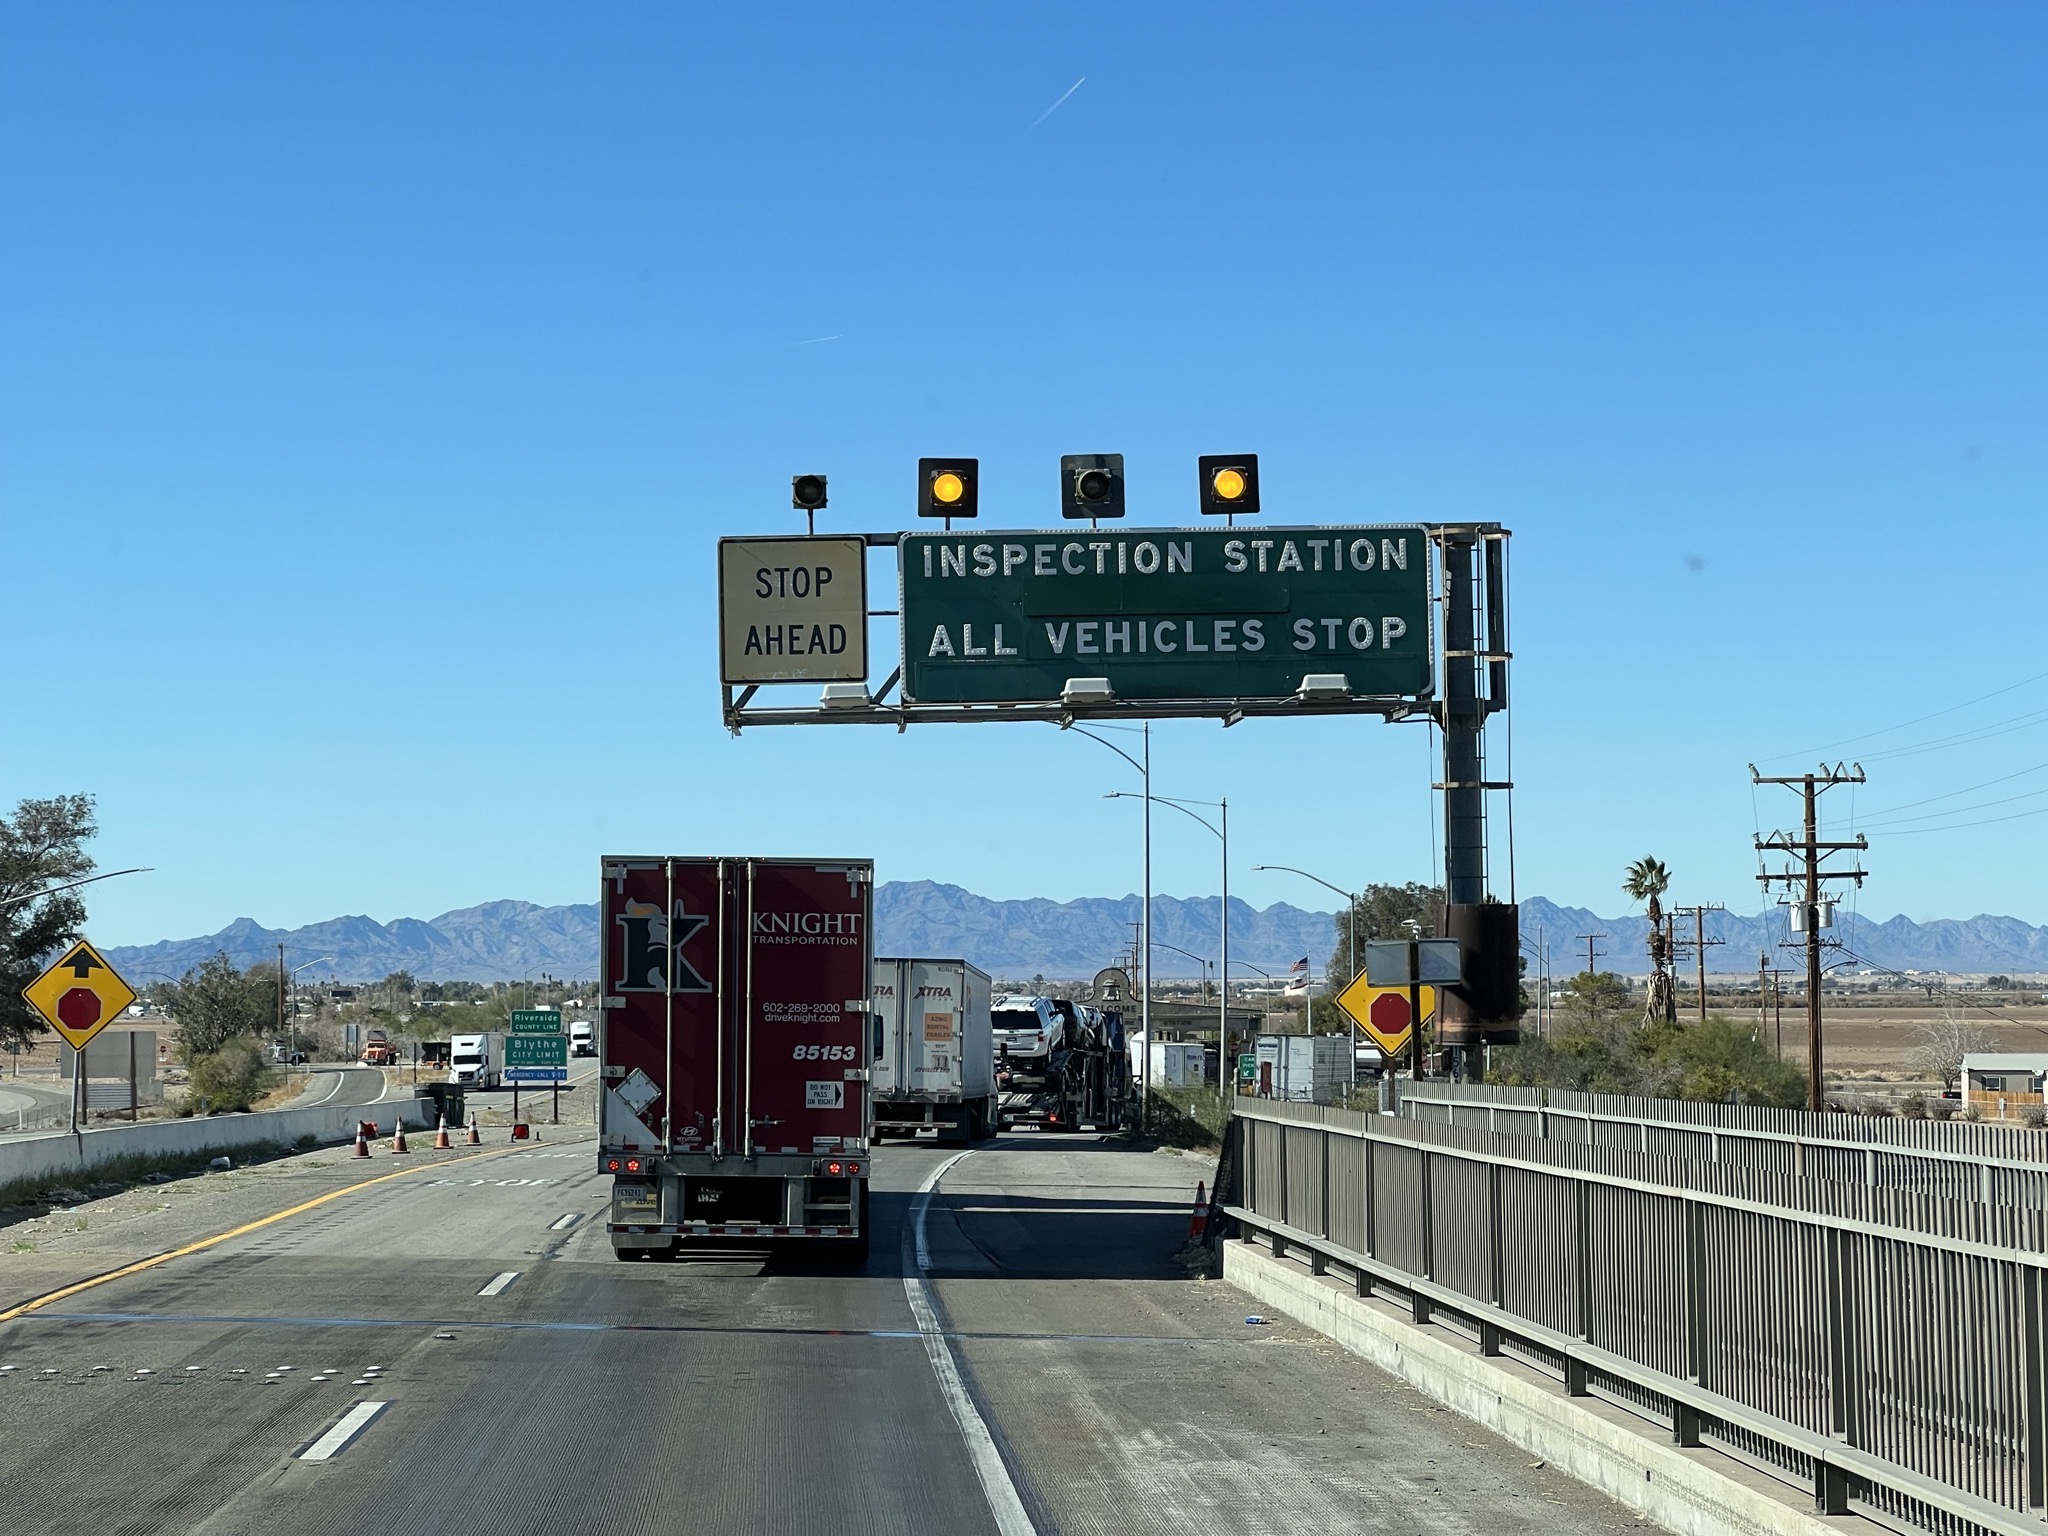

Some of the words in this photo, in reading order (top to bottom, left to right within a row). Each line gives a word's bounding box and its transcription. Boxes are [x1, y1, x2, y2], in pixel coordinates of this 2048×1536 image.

[923, 541, 1193, 577] INSPECTION
[1224, 538, 1408, 573] STATION
[755, 566, 833, 599] STOP
[744, 624, 847, 656] AHEAD
[928, 622, 1018, 657] ALL
[1045, 618, 1266, 655] VEHICLES
[1293, 616, 1407, 651] STOP
[752, 912, 862, 934] KNIGHT
[753, 935, 858, 945] TRANSPORTATION
[874, 985, 894, 996] TRA
[913, 985, 952, 1000] XTRA
[762, 1002, 840, 1013] 602-269-2000
[514, 1014, 558, 1022] Riverside
[764, 1013, 840, 1024] driveknight.com
[514, 1040, 558, 1050] Blythe
[792, 1045, 856, 1061] 85153
